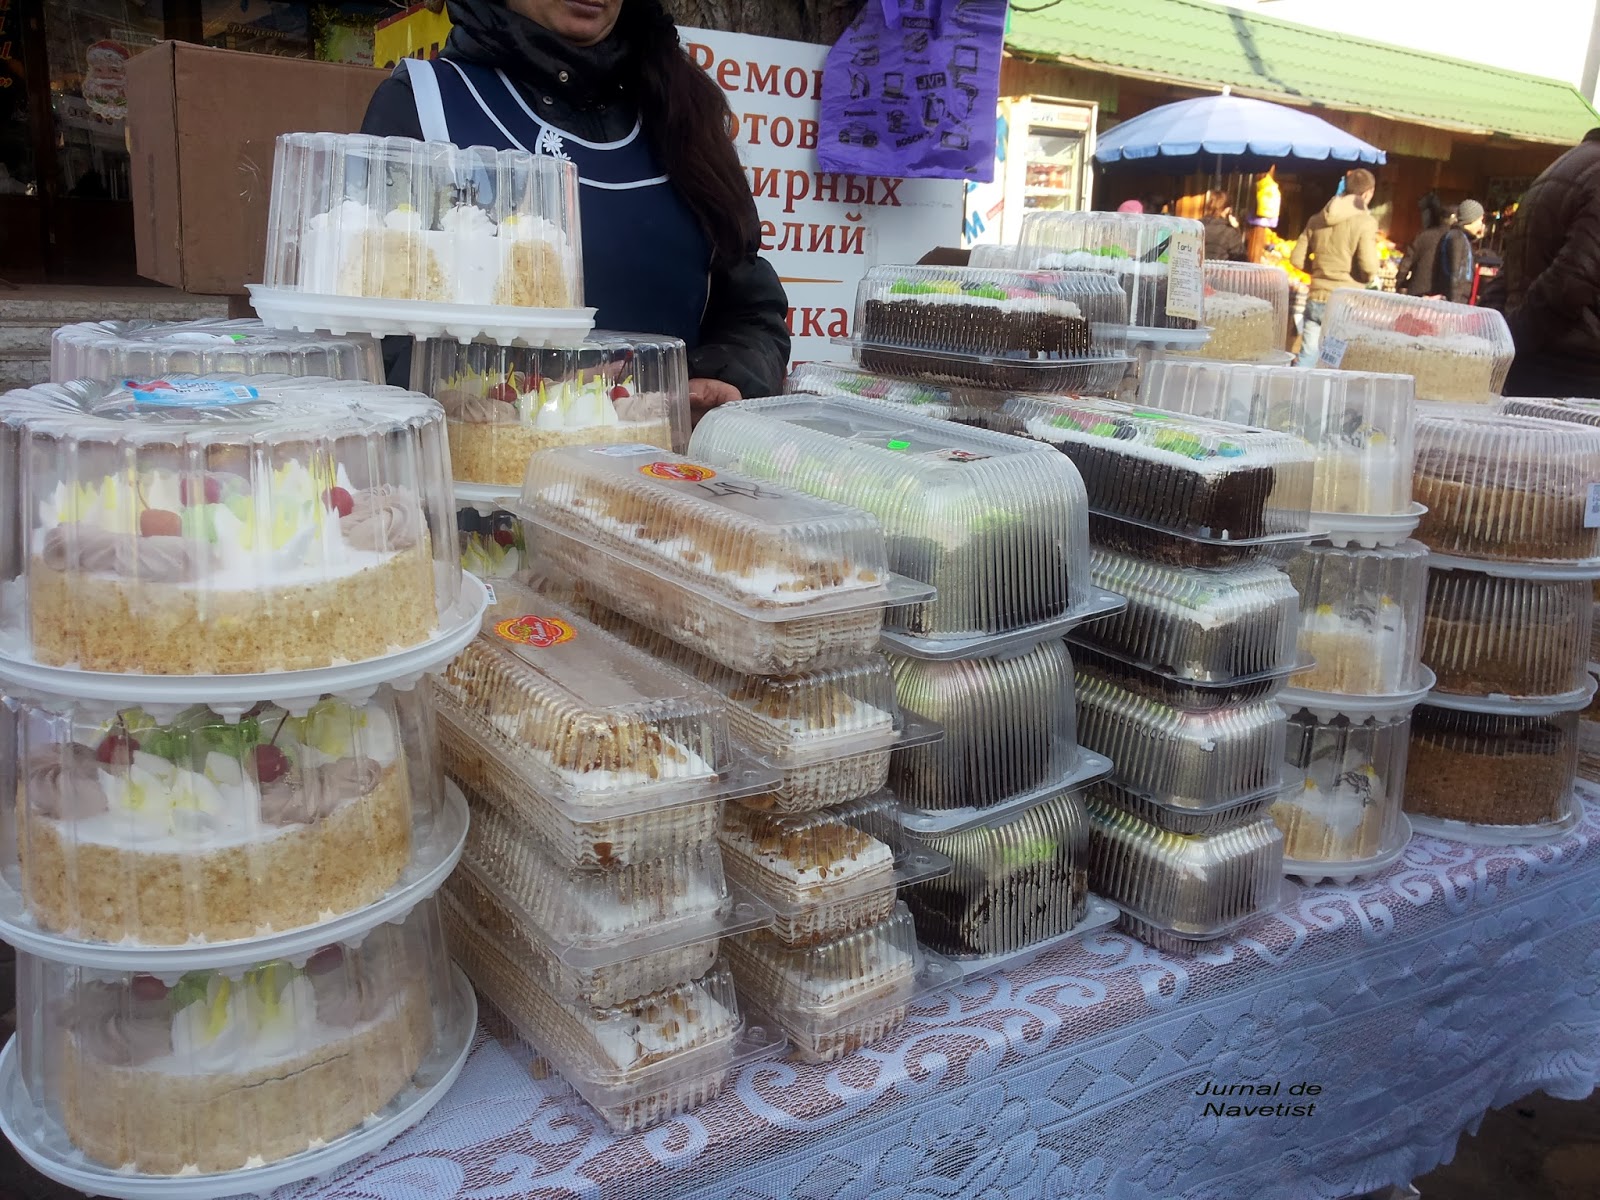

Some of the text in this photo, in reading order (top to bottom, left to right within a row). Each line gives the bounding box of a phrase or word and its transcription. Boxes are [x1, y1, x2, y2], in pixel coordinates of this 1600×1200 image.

[917, 73, 945, 90] JVC
[896, 131, 924, 148] BOSCH
[744, 165, 904, 214] ирных
